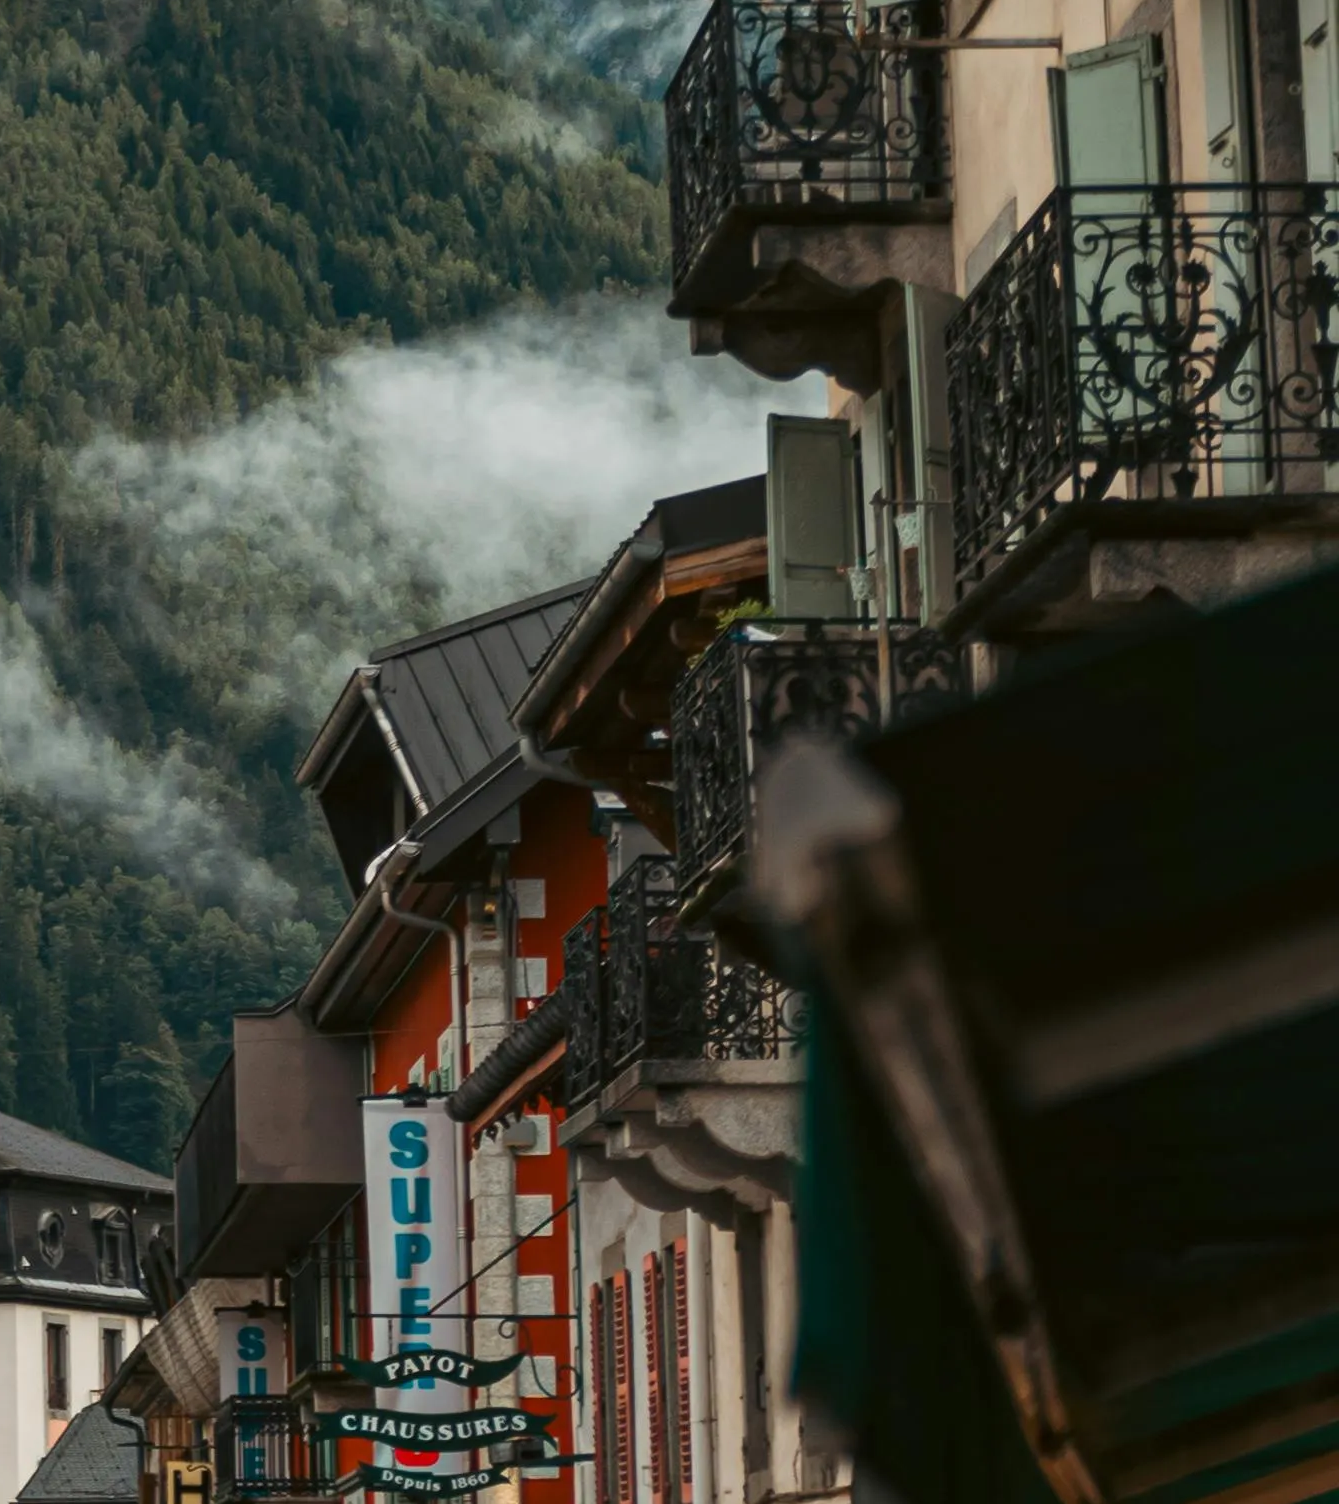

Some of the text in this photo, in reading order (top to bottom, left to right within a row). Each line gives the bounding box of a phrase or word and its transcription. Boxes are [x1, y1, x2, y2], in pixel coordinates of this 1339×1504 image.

[385, 1354, 475, 1381] PAYOT
[340, 1413, 528, 1442] CHAUSSURES
[381, 1469, 491, 1492] Depuis 1860
